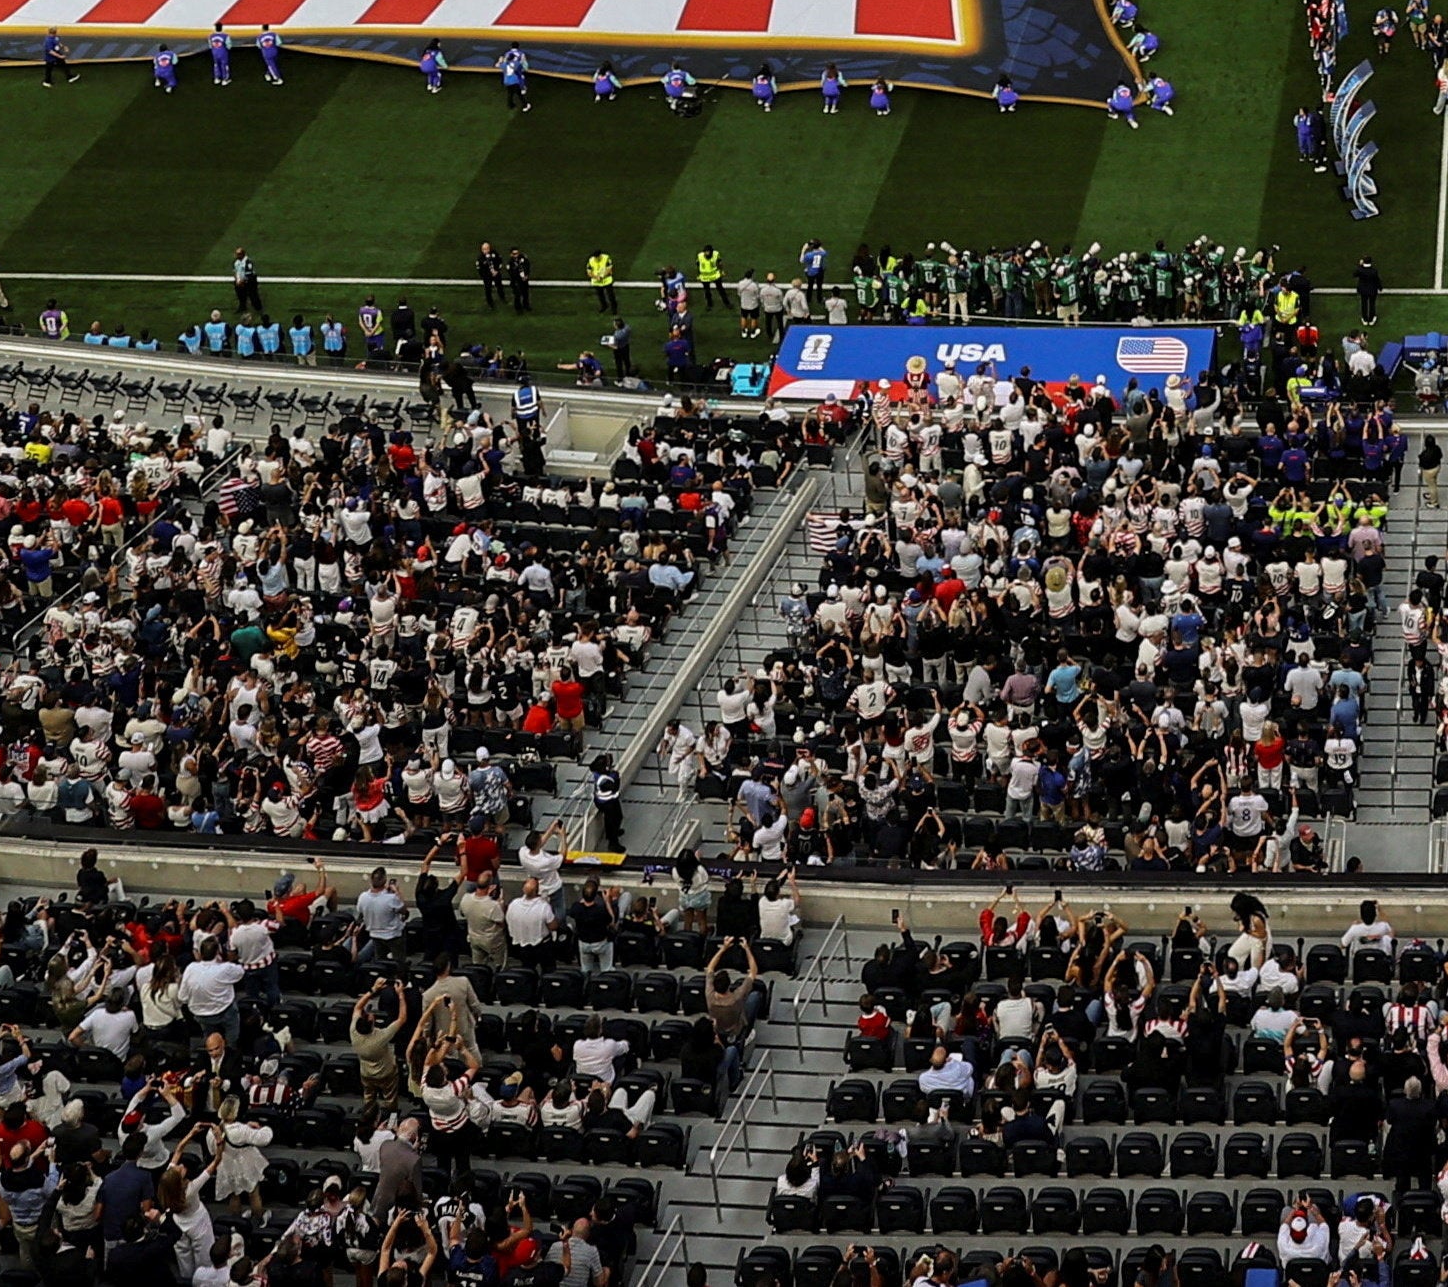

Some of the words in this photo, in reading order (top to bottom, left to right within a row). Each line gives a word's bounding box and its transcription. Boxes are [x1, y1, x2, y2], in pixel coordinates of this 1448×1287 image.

[936, 343, 1006, 363] USA
[994, 440, 1006, 451] 10
[147, 468, 161, 479] 26
[1189, 509, 1199, 520] 10
[241, 544, 248, 556] 7
[1230, 590, 1243, 602] 10
[457, 622, 464, 633] 4
[341, 669, 355, 682] 16
[373, 670, 387, 684] 14
[499, 688, 507, 699] 2
[869, 693, 877, 706] 2
[1333, 752, 1347, 765] 19
[1241, 807, 1250, 821] 8
